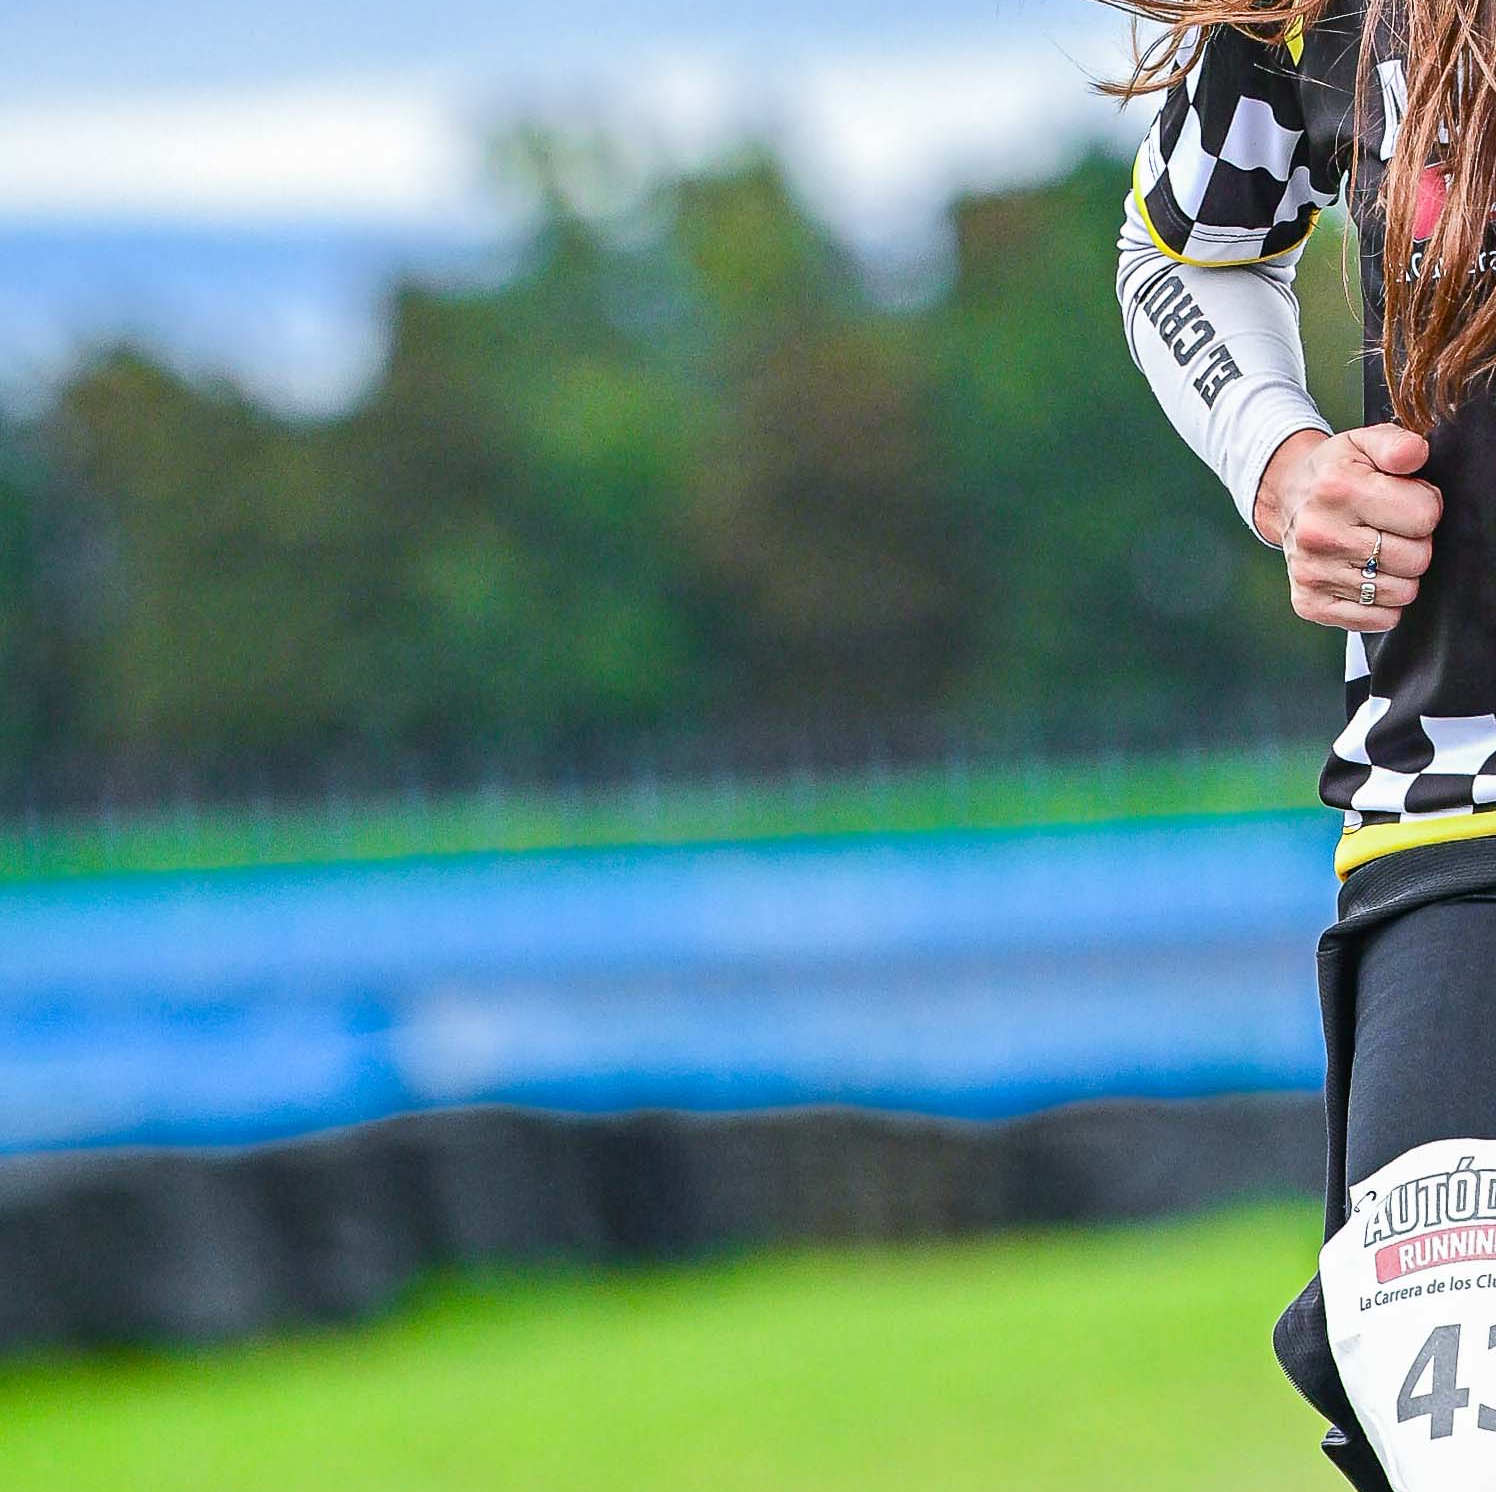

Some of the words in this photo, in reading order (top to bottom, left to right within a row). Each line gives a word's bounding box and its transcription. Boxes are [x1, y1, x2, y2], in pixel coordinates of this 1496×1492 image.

[1142, 275, 1217, 367] CRU
[1193, 343, 1244, 410] EL
[1360, 1296, 1373, 1312] La
[1374, 1283, 1423, 1307] Carrera
[1426, 1278, 1446, 1295] de
[1449, 1275, 1472, 1291] los
